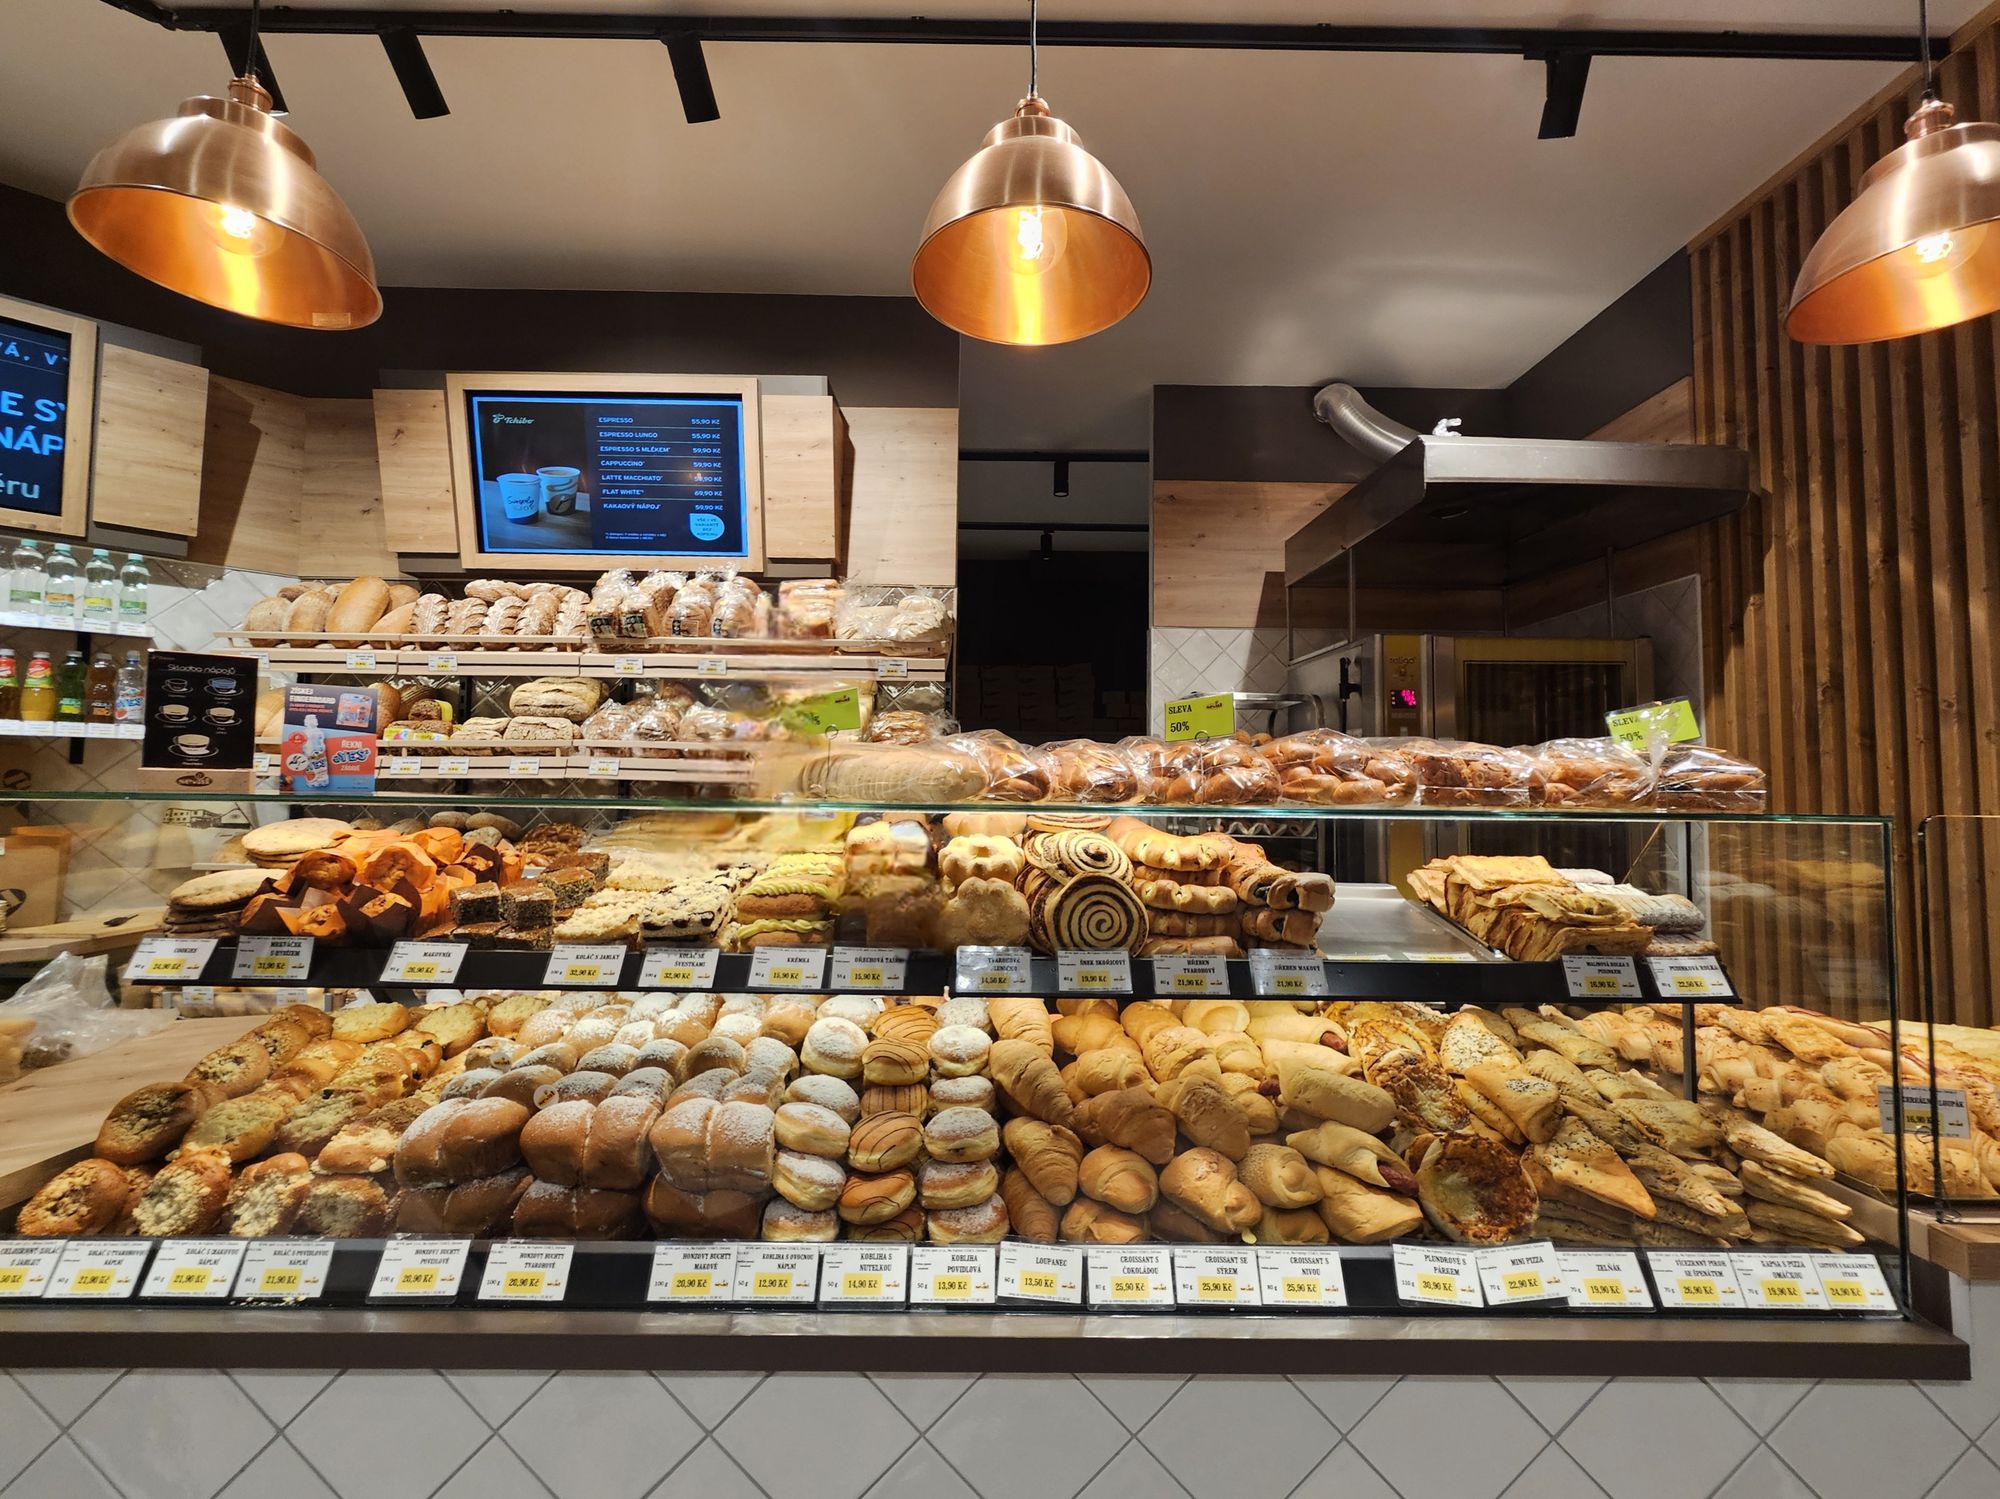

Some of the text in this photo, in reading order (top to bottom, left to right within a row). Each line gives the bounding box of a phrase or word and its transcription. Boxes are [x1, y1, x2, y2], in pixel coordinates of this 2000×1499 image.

[34, 398, 66, 422] S
[504, 416, 535, 424] Tchibo
[168, 664, 236, 675] Skladba nápojů
[1168, 704, 1192, 715] SLEVA
[1170, 720, 1190, 733] 50%
[1619, 730, 1644, 742] 50%
[587, 968, 597, 976] Kč
[870, 972, 881, 980] Kč
[1098, 975, 1107, 983] Kč
[1294, 980, 1303, 988] Kč
[951, 1254, 978, 1262] KOBLIHA
[1035, 1257, 1068, 1267] LOUPANEC
[1120, 1256, 1154, 1264] CROISSANT
[1205, 1256, 1240, 1264] CROISSANT
[1290, 1256, 1325, 1265] CROISSANT
[1424, 1254, 1461, 1265] PLUNDROVÉ
[1510, 1256, 1545, 1267] MINI PIZZA
[694, 1262, 719, 1270] MAKOVÉ
[776, 1262, 797, 1270] NÁPLNÍ
[859, 1264, 892, 1272] NUTELKOU
[947, 1265, 982, 1273] POVIDLOVÁ
[1122, 1266, 1159, 1275] ČOKOLÁDOU
[1216, 1266, 1239, 1275] SÝREM
[1433, 1265, 1460, 1276] PÁRKEM
[1595, 1263, 1623, 1272] ZELŇÁK
[1301, 1268, 1321, 1276] NIVOU
[98, 1276, 110, 1284] Kč
[195, 1275, 206, 1283] Kč
[286, 1275, 297, 1284] Kč
[422, 1274, 433, 1283] Kč
[529, 1278, 540, 1287] Kč
[1024, 1277, 1054, 1288] 13,50 Kč
[676, 1279, 708, 1288] 20,90 Kč
[758, 1279, 789, 1288] 12,90 Kč
[848, 1280, 878, 1289] 14,90 Kč
[937, 1281, 968, 1290] 13,90 Kč
[1115, 1282, 1145, 1292] 25,90 Kč
[1202, 1283, 1233, 1292] 25,90 Kč
[1286, 1283, 1317, 1293] 25,90 Kč
[1422, 1280, 1454, 1292] 30,90 Kč
[1508, 1279, 1539, 1289] 22,90 Kč
[1590, 1285, 1621, 1294] 19,90 Kč
[1703, 1286, 1714, 1295] Kč
[1787, 1288, 1799, 1296] Kč
[1851, 1288, 1861, 1297] Kč
